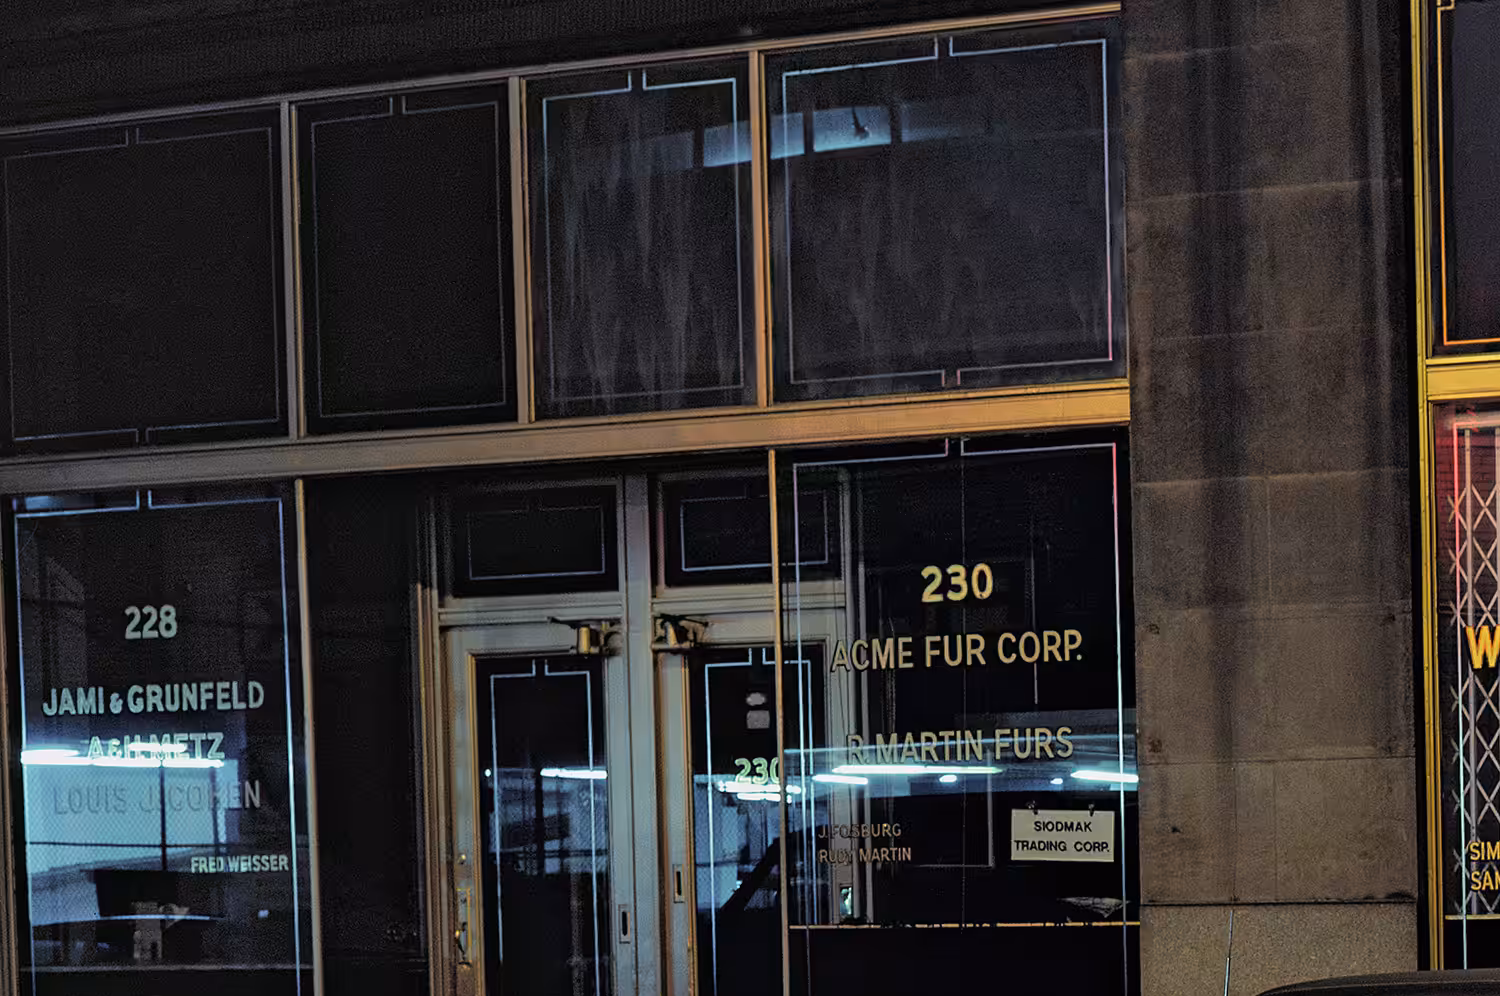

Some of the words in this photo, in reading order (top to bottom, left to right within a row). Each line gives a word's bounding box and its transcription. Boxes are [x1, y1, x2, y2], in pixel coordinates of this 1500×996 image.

[920, 563, 994, 603] 230
[125, 604, 178, 639] 228
[830, 637, 913, 673] ACME
[925, 633, 986, 667] FUR
[999, 629, 1083, 663] CORP.
[42, 687, 104, 716] JAMI
[109, 692, 123, 714] &
[127, 681, 265, 713] GRUNFELD
[846, 734, 870, 765] R.
[875, 729, 983, 763] MARTIN
[994, 726, 1074, 760] FURS
[53, 785, 128, 814] LOUIS
[167, 780, 261, 811] COHEN
[832, 823, 902, 838] FOSBURG
[1033, 820, 1092, 833] SIODMAK
[859, 847, 912, 862] MARTIN
[1015, 840, 1067, 852] TRADING
[1074, 840, 1110, 853] CORP.
[191, 856, 224, 874] FRED
[227, 854, 289, 872] WEISSER
